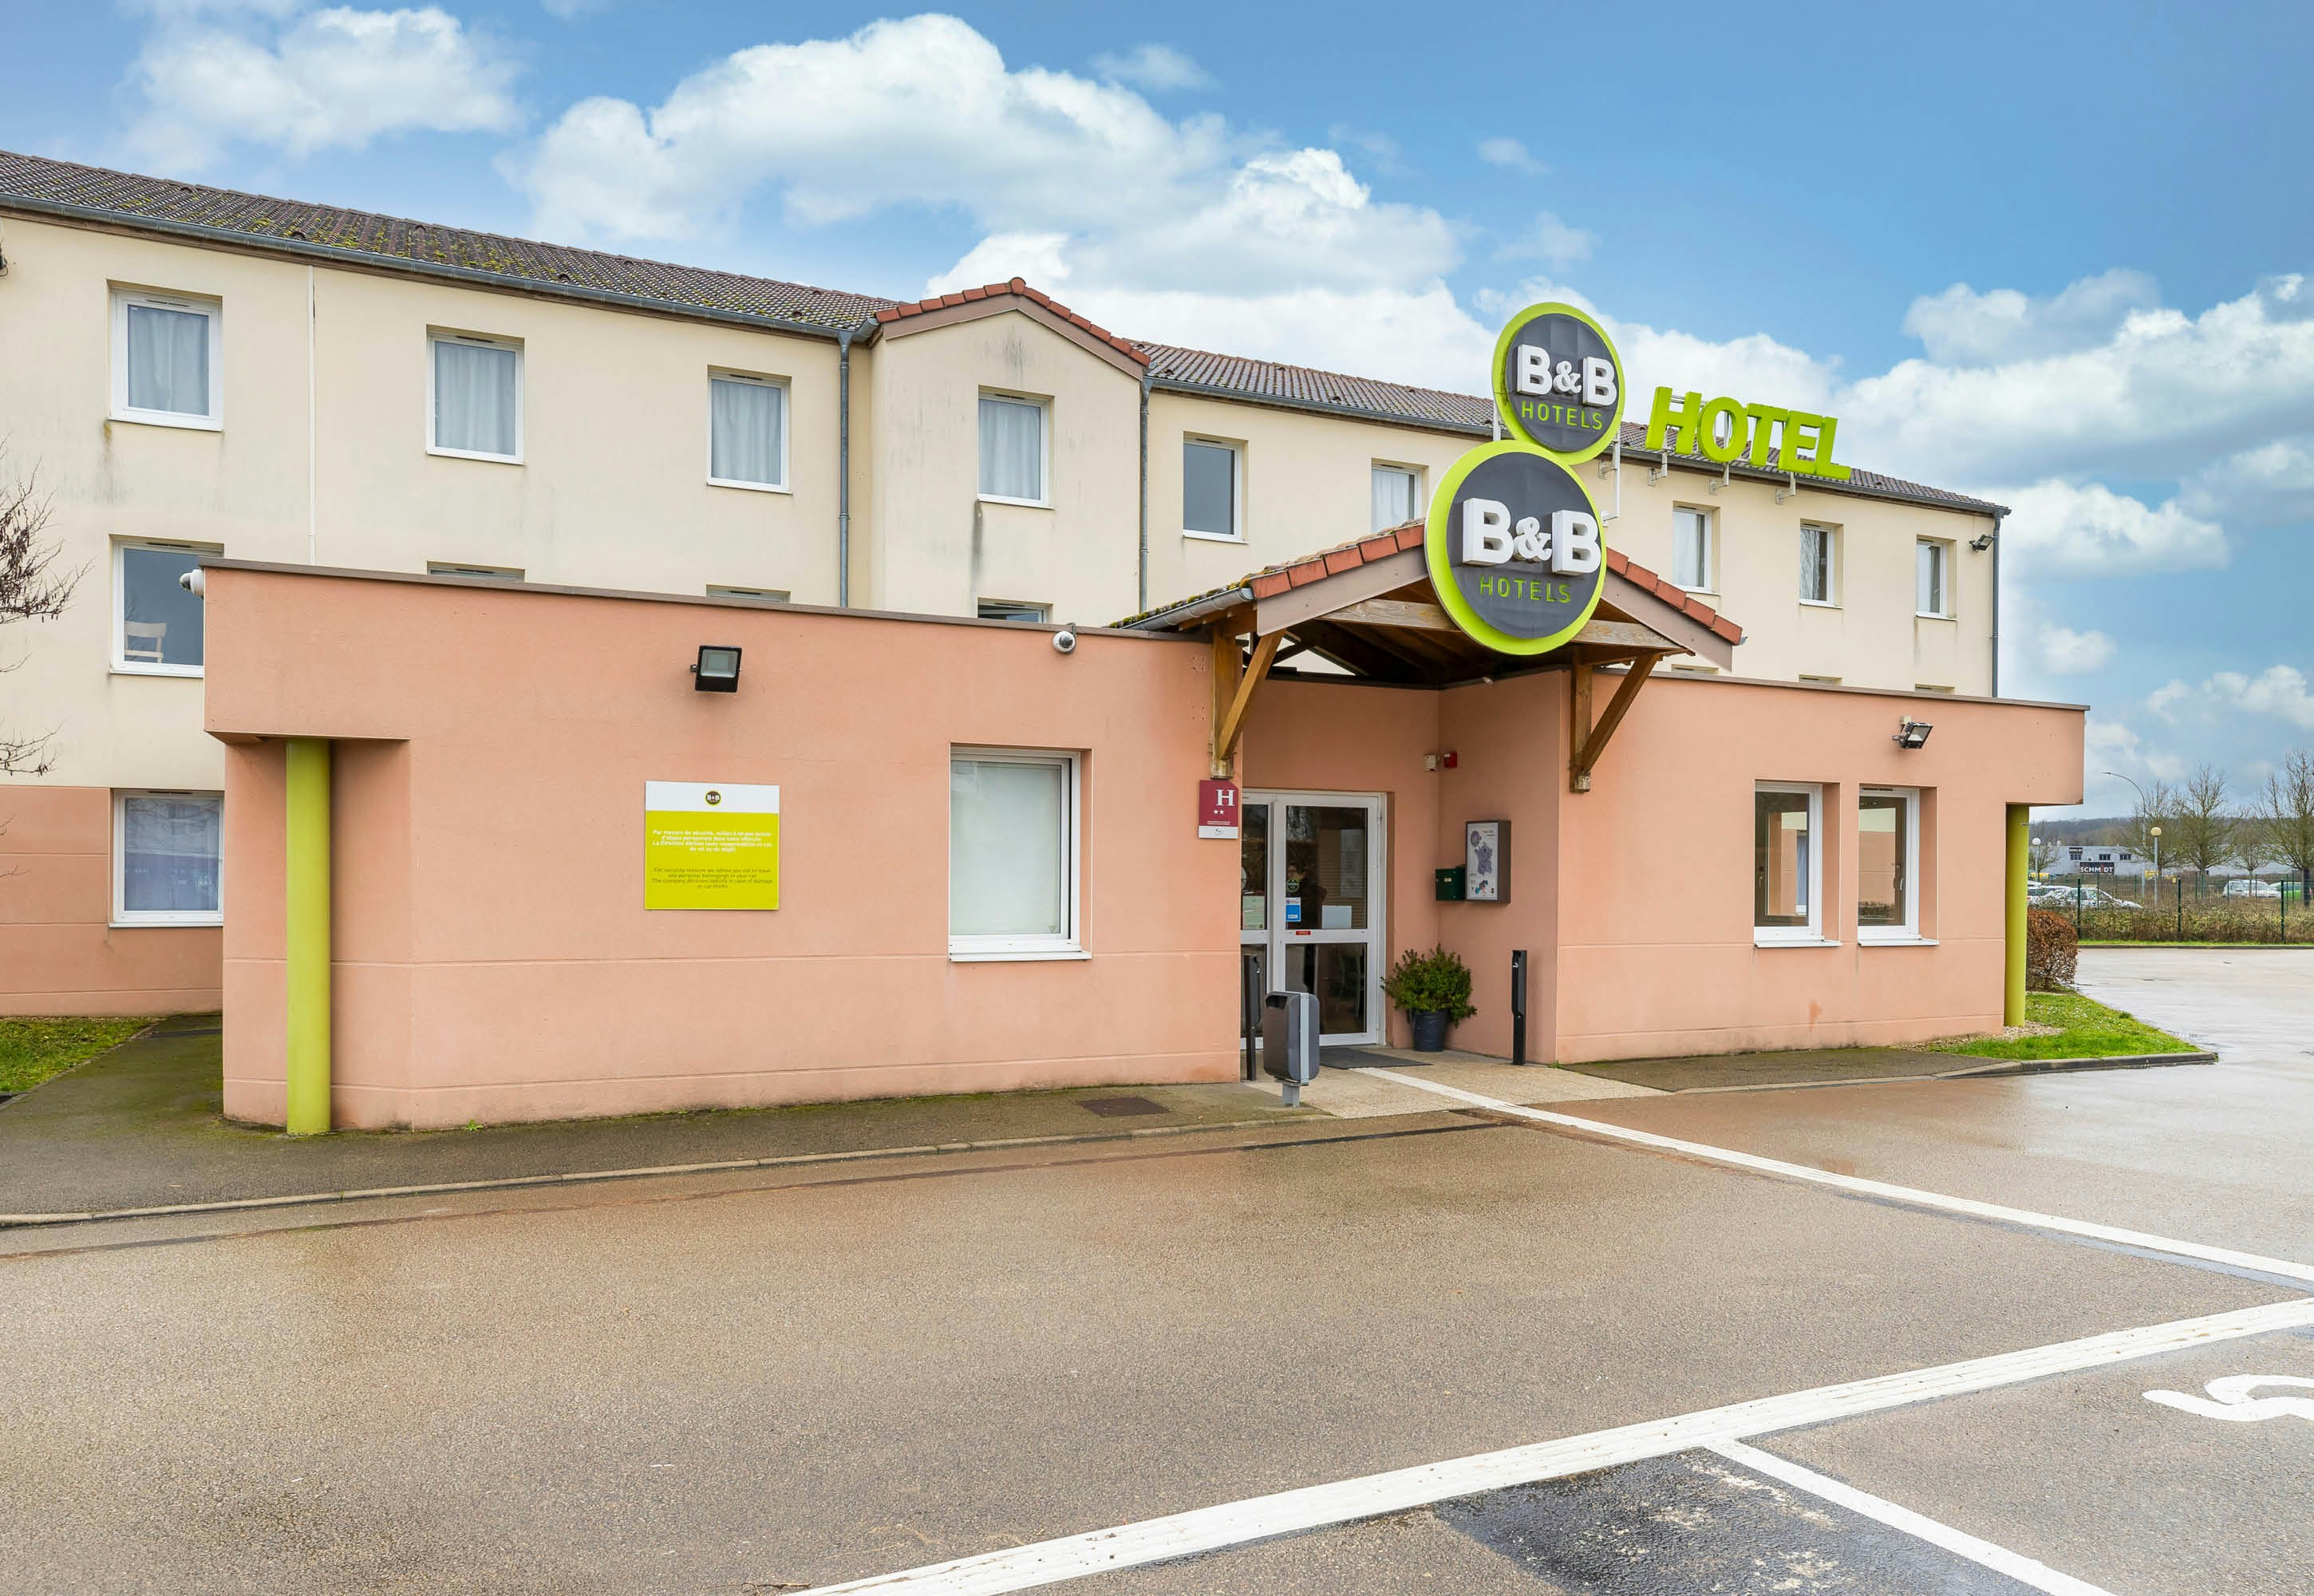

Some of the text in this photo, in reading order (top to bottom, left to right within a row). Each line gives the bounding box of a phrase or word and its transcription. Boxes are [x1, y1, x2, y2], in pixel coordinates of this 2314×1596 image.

[1516, 344, 1617, 407] B&B
[1522, 401, 1603, 430] HOTELS
[1645, 386, 1851, 480] HOTEL
[1463, 497, 1601, 575] B&B
[1479, 575, 1571, 604] HOTELS
[1215, 788, 1235, 807] H
